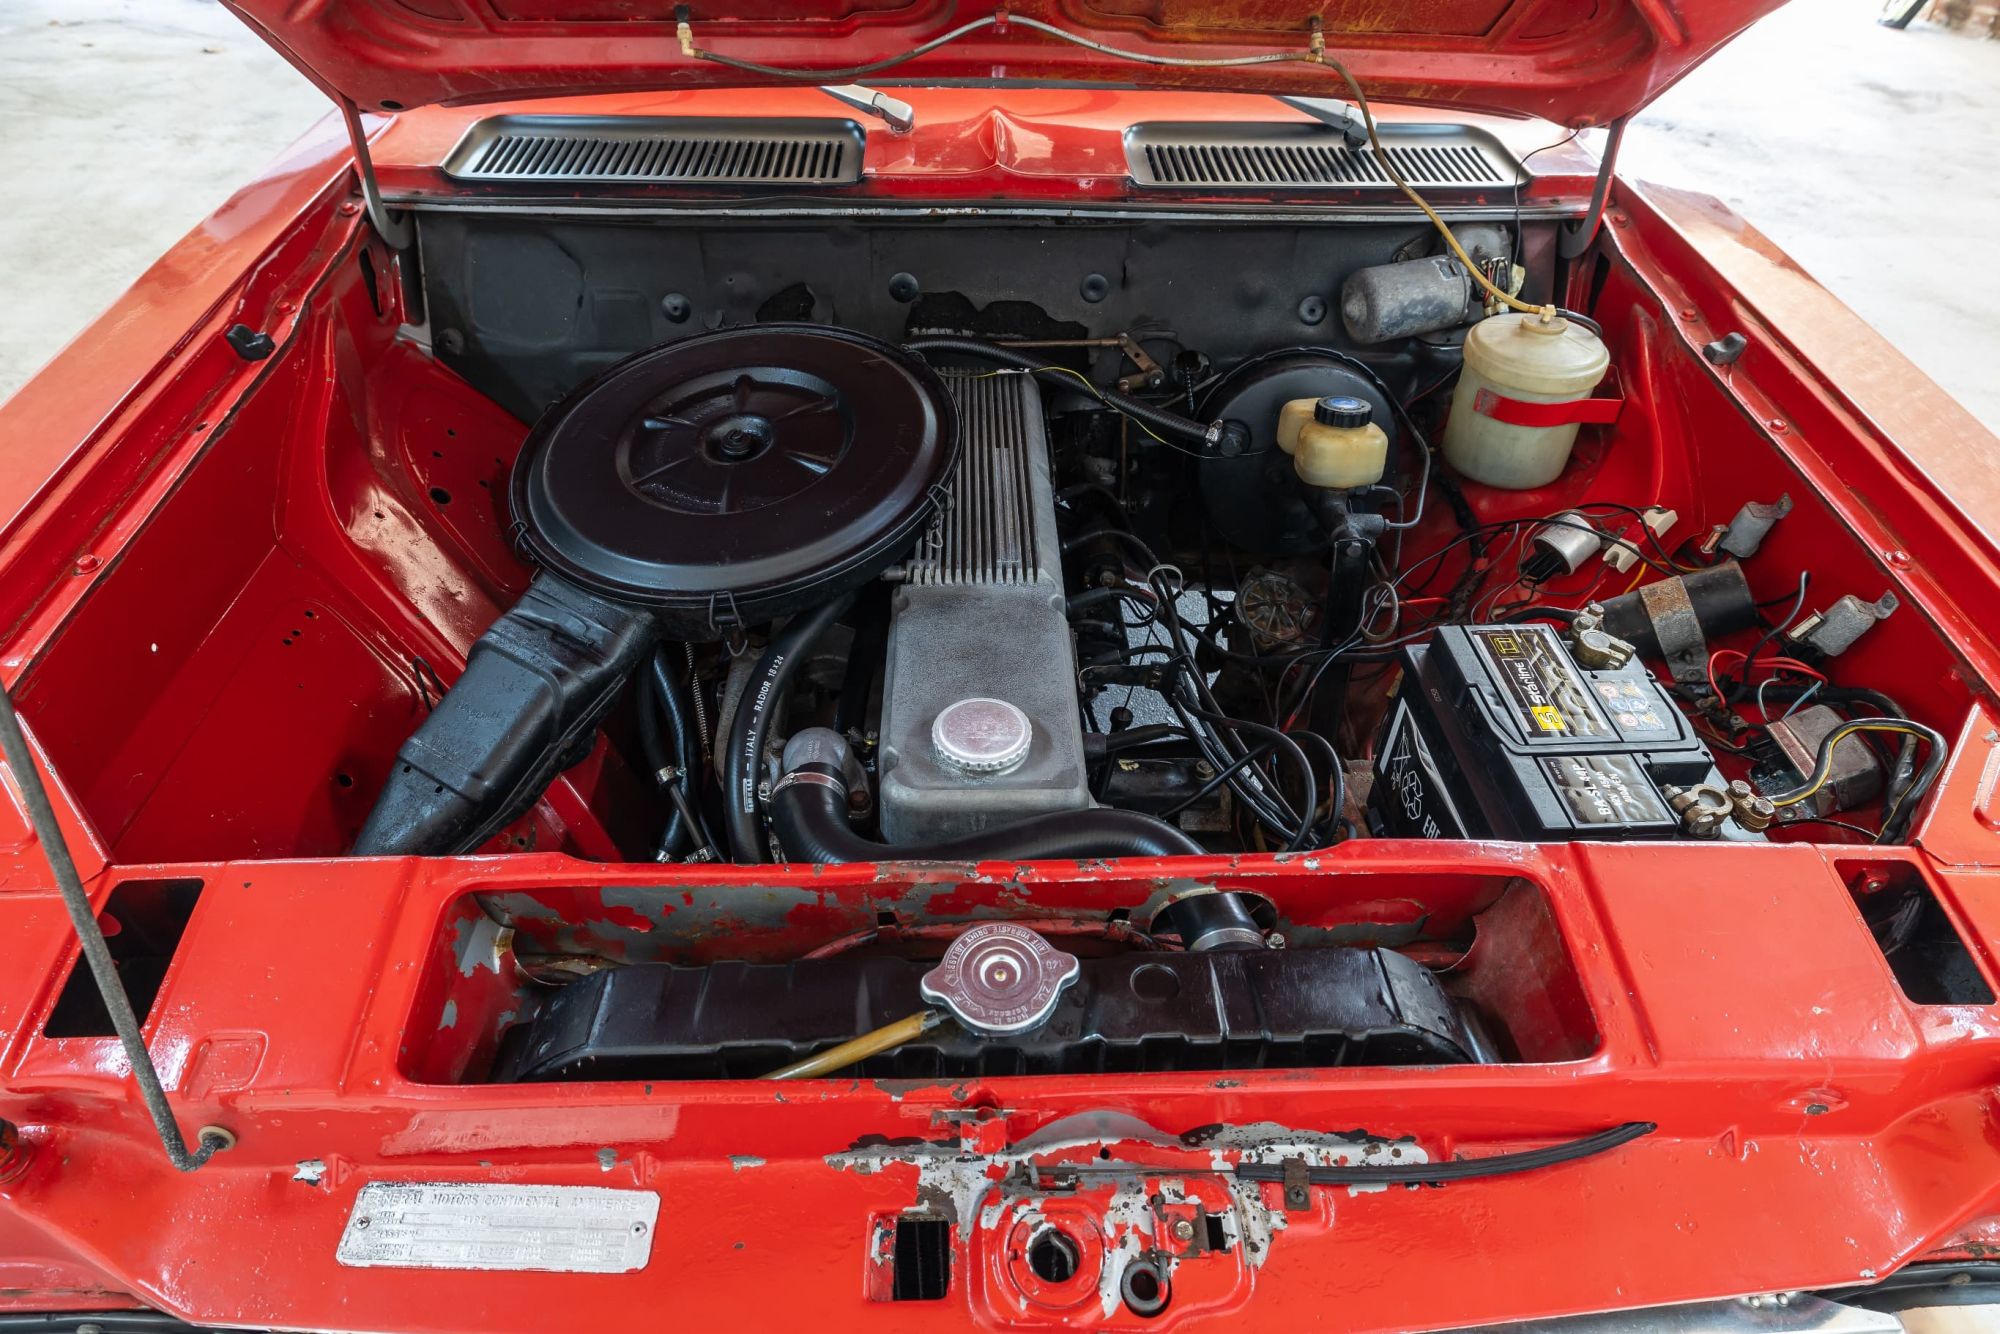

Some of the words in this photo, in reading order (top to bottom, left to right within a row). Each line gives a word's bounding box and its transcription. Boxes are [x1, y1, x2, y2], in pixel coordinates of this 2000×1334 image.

[1514, 661, 1546, 705] Starline
[744, 729, 757, 757] ITALY
[754, 680, 772, 713] RADIOR
[768, 655, 784, 677] 18x24
[1572, 764, 1591, 782] 44P
[1585, 783, 1601, 797] SL
[1594, 798, 1612, 816] BA
[965, 929, 989, 944] DRUCK
[993, 924, 1031, 941] VORRASTE
[1030, 939, 1048, 955] AUF
[368, 1191, 424, 1207] GENERAL
[431, 1192, 479, 1207] MOTORS
[484, 1194, 560, 1209] CONTINENTAL
